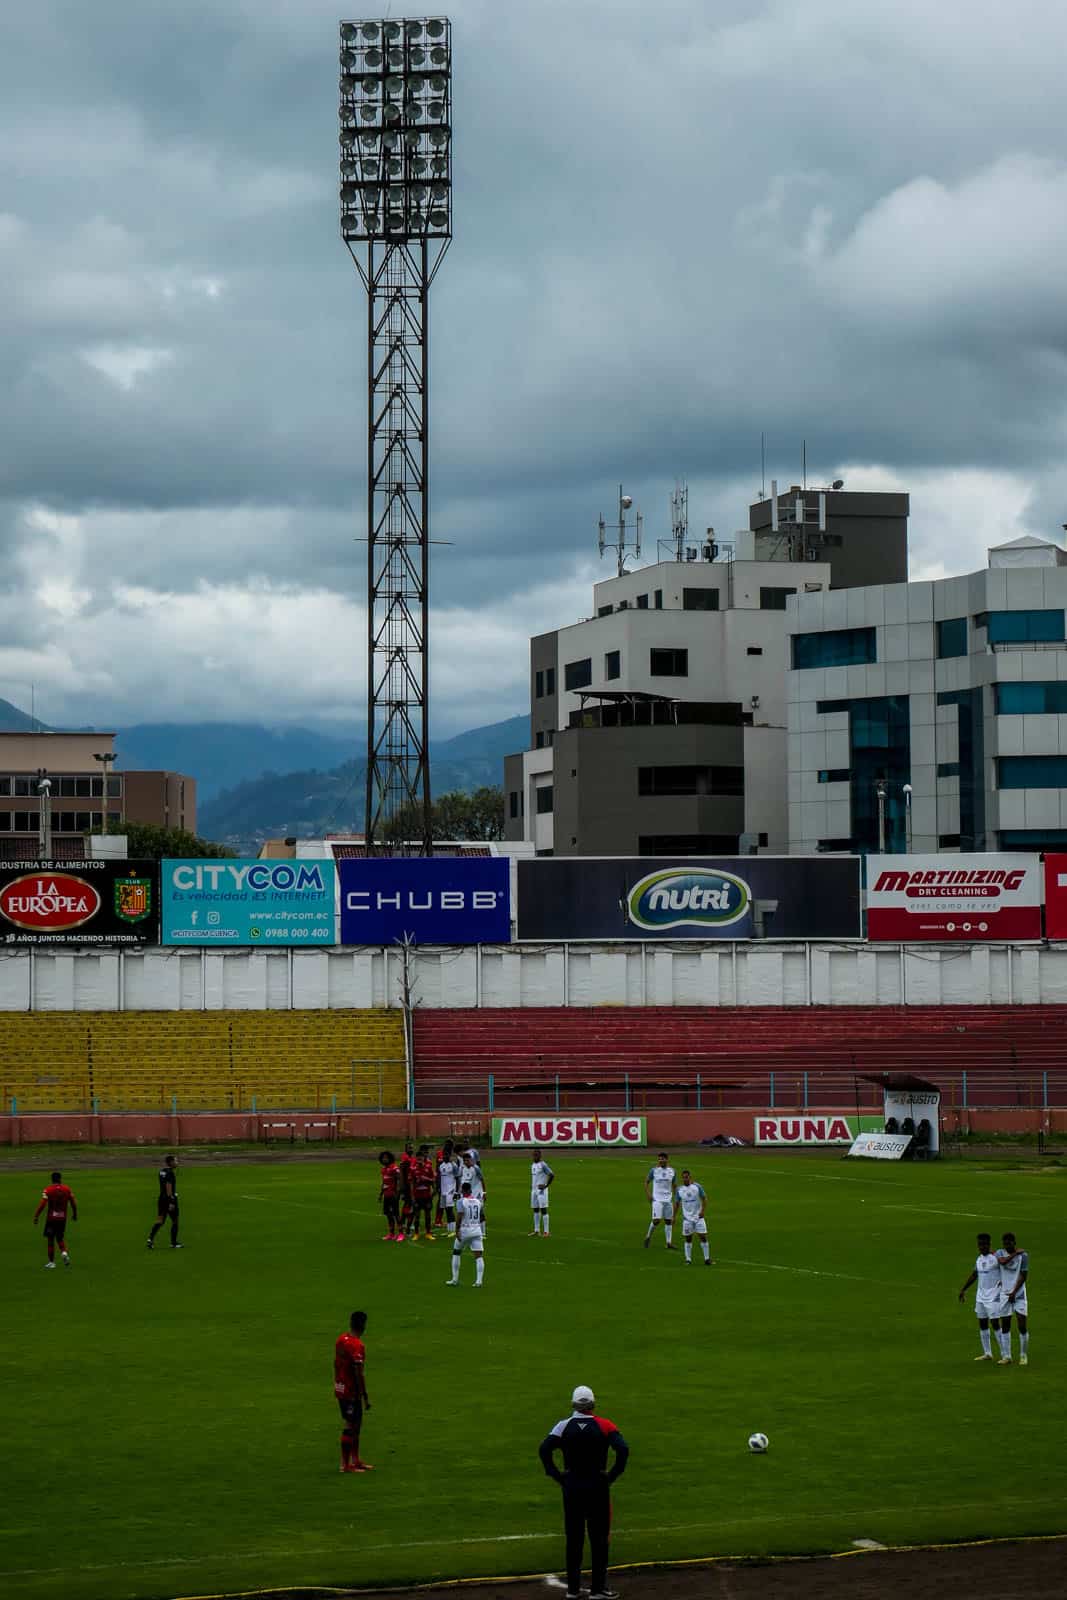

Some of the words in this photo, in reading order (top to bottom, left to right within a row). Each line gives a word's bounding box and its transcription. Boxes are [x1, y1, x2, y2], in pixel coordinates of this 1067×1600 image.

[41, 861, 54, 869] DE
[55, 861, 105, 869] ALIMENTOS
[172, 864, 325, 891] CITYCOM
[873, 869, 1027, 892] MARTINIZING
[37, 880, 59, 896] LA
[940, 888, 988, 896] CLEANING
[189, 892, 248, 901] velocidad
[347, 891, 497, 910] CHUBB
[649, 882, 732, 910] nutri
[8, 895, 89, 915] EUROPEA
[249, 911, 329, 921] www.citycom.ec
[38, 935, 65, 943] JUNTOS
[265, 928, 289, 938] 0988
[291, 928, 308, 938] 000
[311, 928, 329, 938] 400
[502, 1120, 639, 1141] MUSHUC
[759, 1120, 851, 1141] RUNA
[873, 1141, 904, 1151] austro
[468, 1205, 478, 1220] 13
